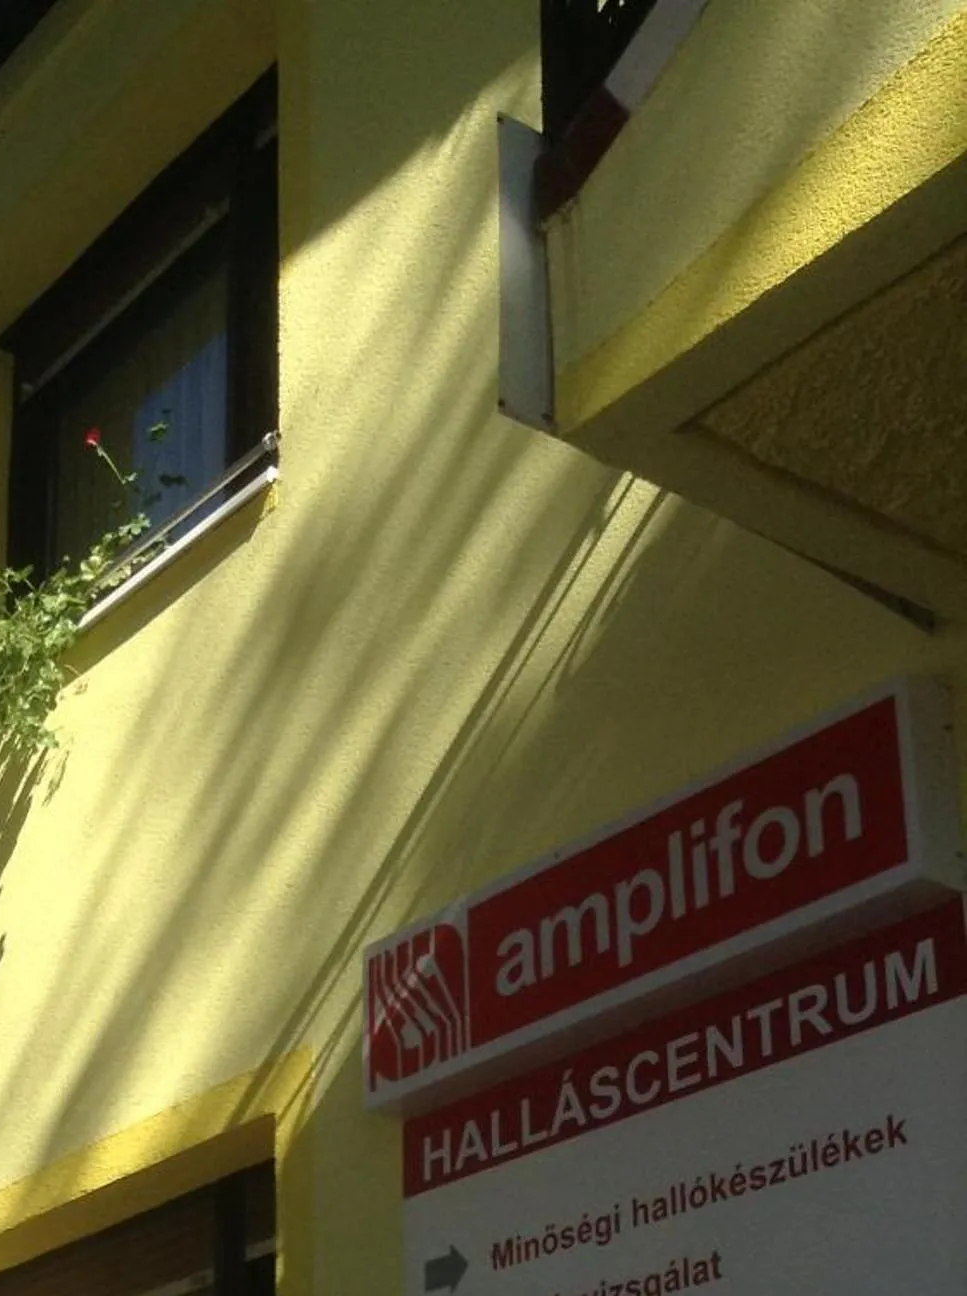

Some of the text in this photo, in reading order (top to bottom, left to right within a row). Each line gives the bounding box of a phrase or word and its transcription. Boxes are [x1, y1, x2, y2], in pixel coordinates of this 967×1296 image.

[494, 773, 864, 997] amplifon
[422, 938, 940, 1182] HALLÁSCENTRUM
[490, 1114, 908, 1272] Minőségi hallókészülékek
